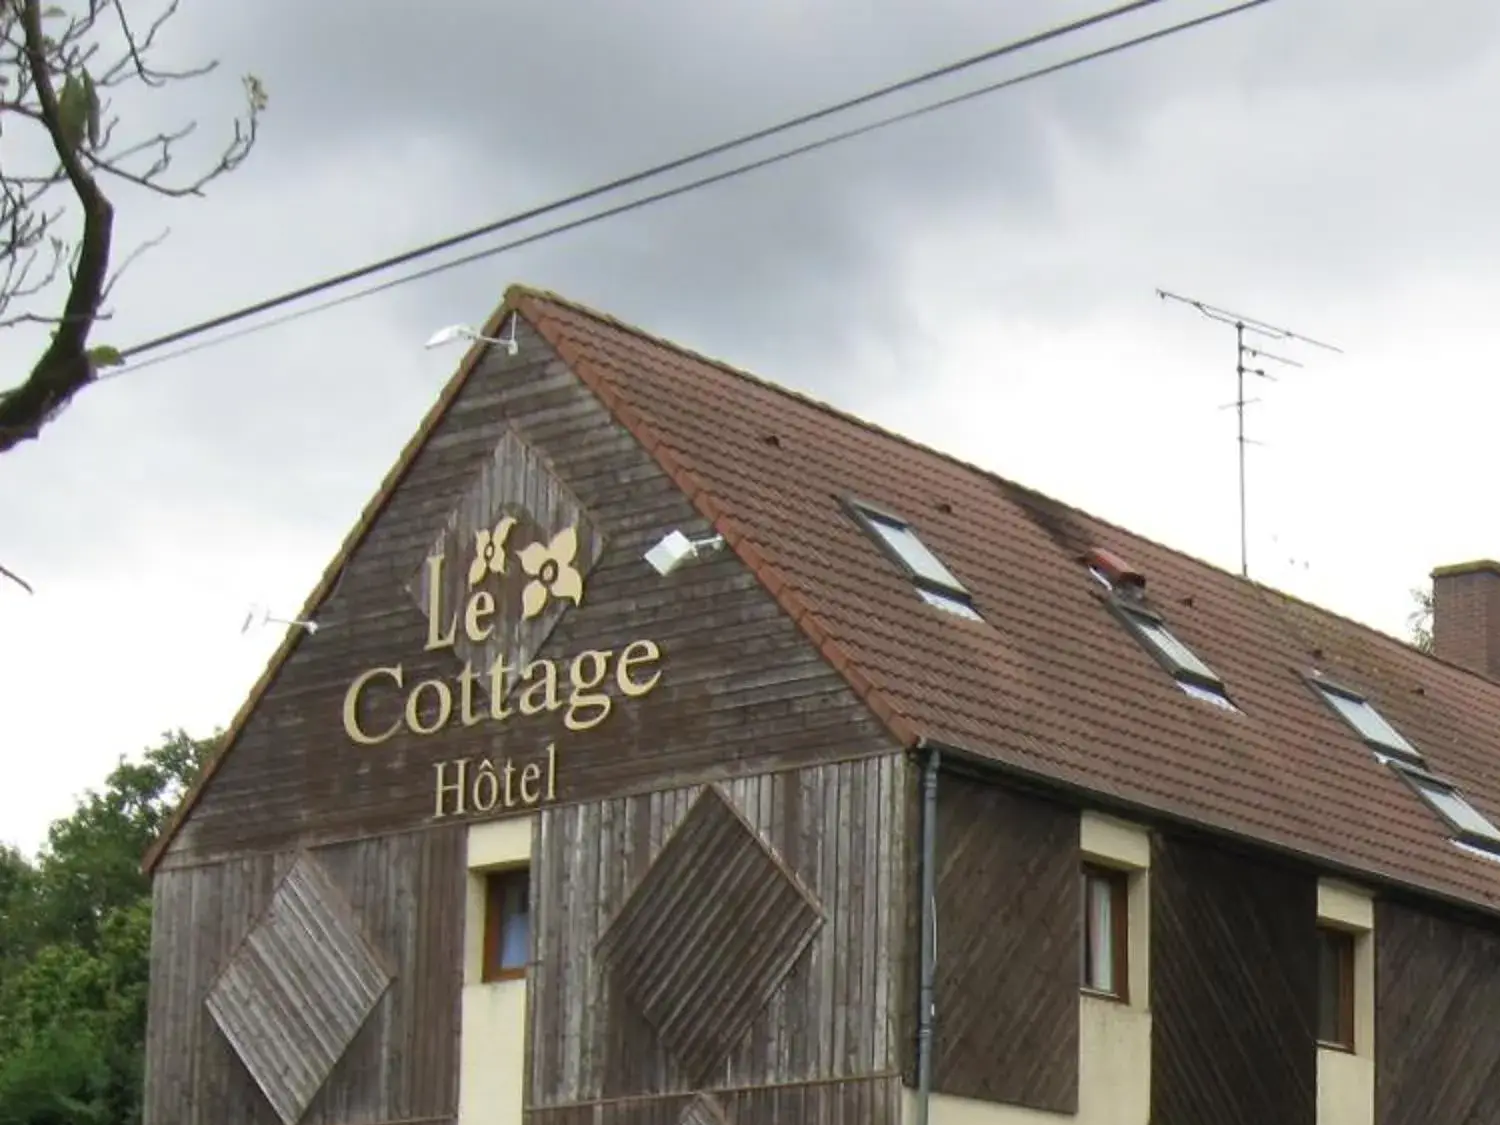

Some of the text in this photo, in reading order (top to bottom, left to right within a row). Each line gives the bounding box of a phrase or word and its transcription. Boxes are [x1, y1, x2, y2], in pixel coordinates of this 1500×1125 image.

[424, 553, 496, 652] Le
[343, 639, 663, 745] Cottage
[432, 743, 556, 818] Hôtel
